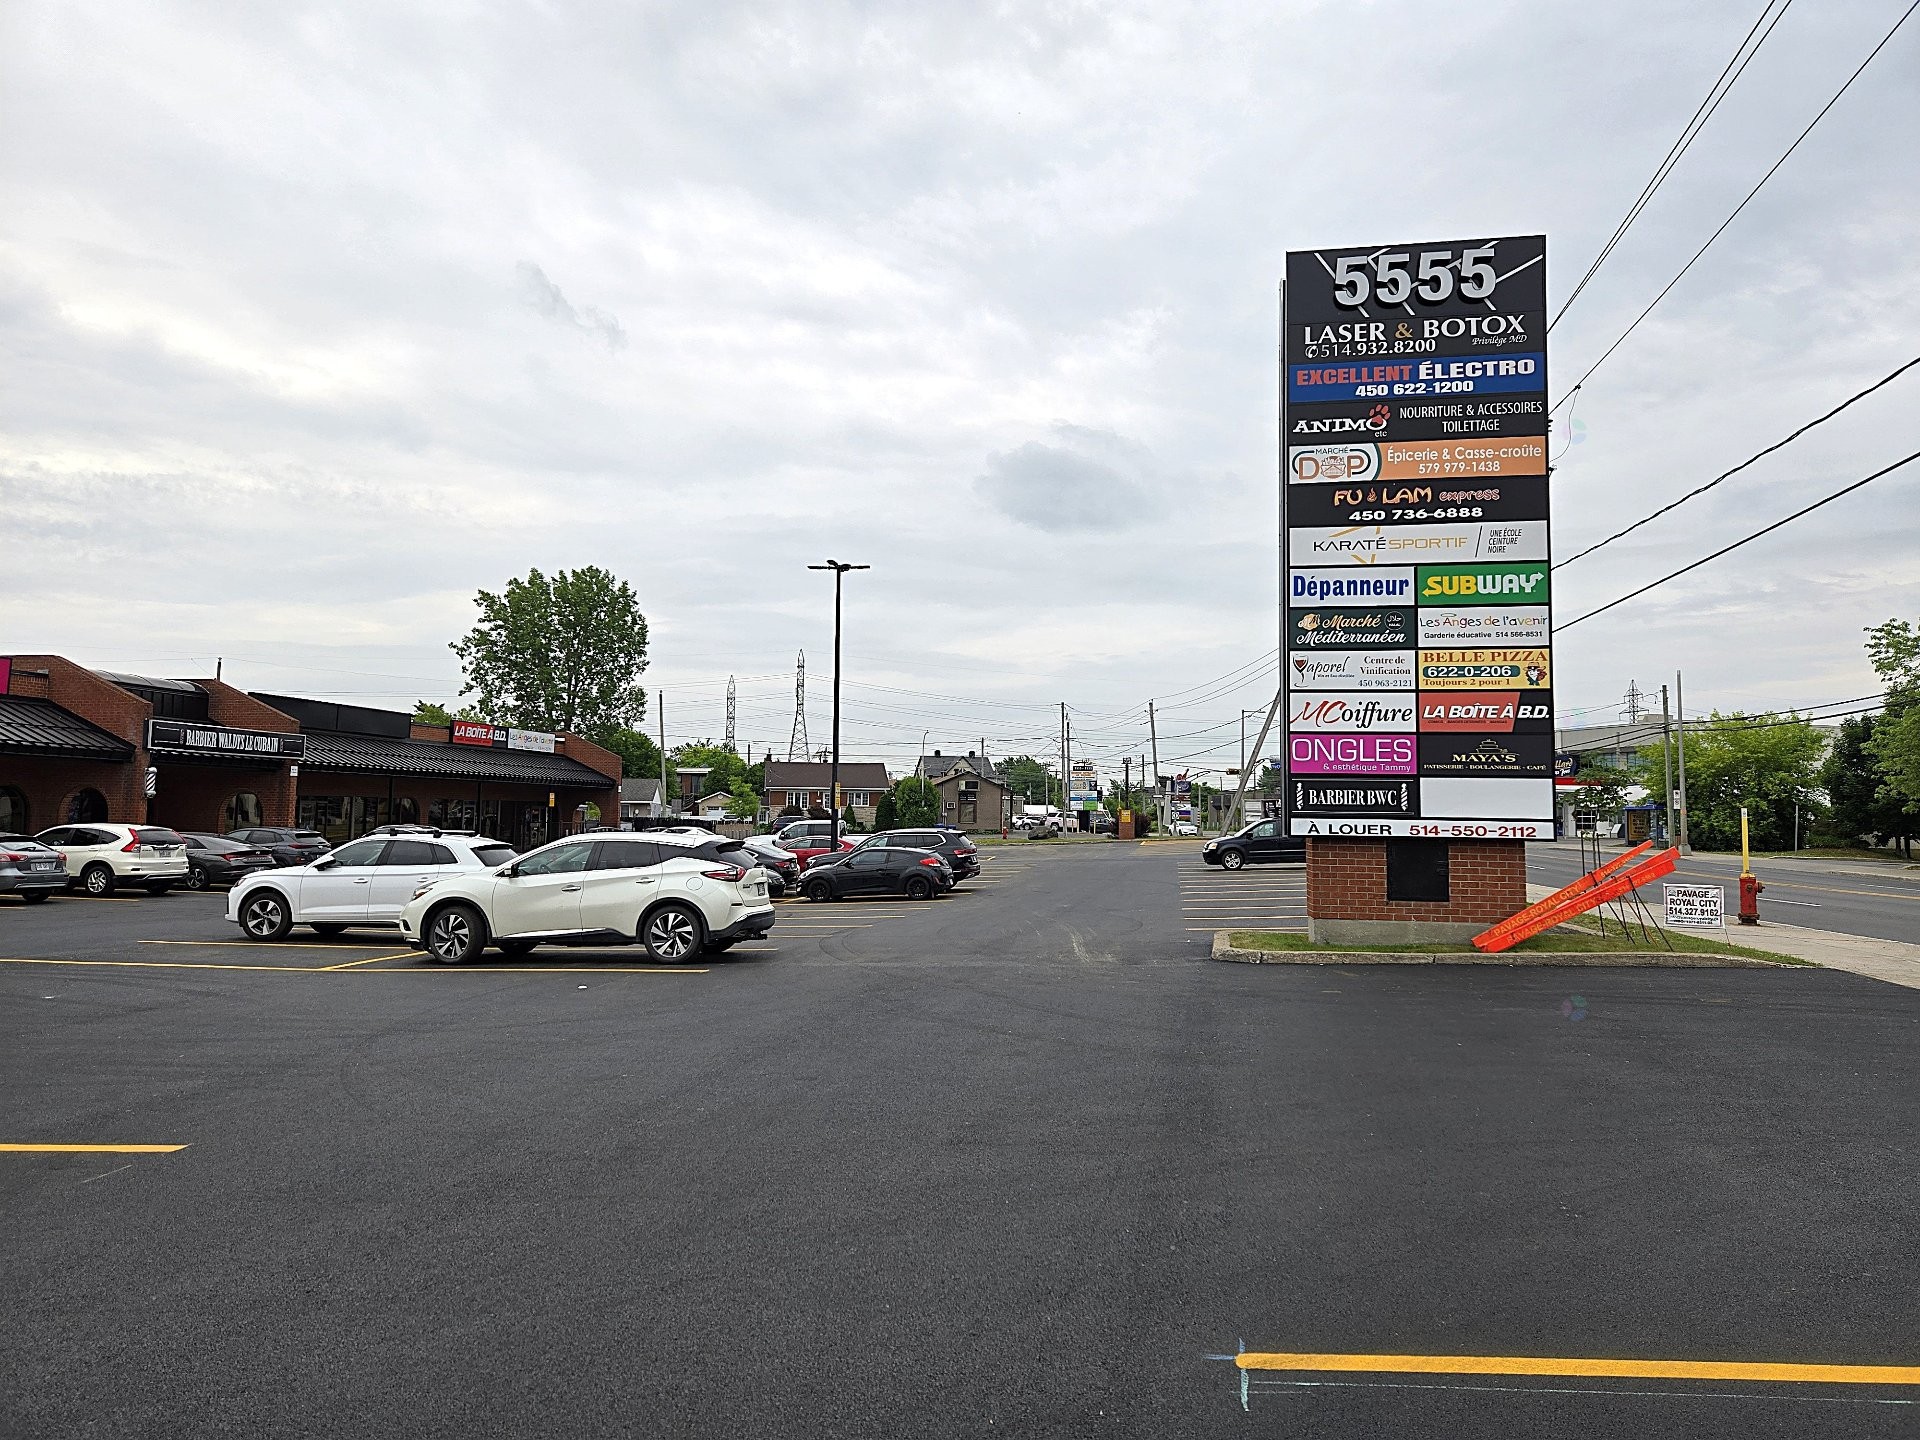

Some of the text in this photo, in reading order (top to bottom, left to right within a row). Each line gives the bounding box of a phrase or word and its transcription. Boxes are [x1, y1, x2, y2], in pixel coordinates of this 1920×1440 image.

[1334, 248, 1498, 306] 5555
[1304, 314, 1525, 345] LASER & BOTOX
[1320, 339, 1436, 359] 514.932.8200
[1296, 359, 1536, 386] EXCELLENT ÉLECTRO
[1355, 380, 1474, 397] 450 622-1200
[1400, 401, 1543, 419] NOURRITURE & ACCESSOIRES
[1292, 417, 1388, 434] ANIMO
[1442, 419, 1500, 433] TOILETTAGE
[1374, 430, 1388, 438] etc
[1315, 446, 1349, 455] MARCHÉ
[1387, 443, 1542, 465] Épicerie & Casse-croûte
[1418, 460, 1500, 474] 579 979-1438
[1333, 486, 1500, 507] FU LAM express
[1349, 507, 1483, 521] 450 736-6888
[1489, 527, 1522, 537] UNE ÉCOLE
[1488, 537, 1518, 545] CEINTURE
[1487, 545, 1507, 554] NOIRE
[1293, 575, 1410, 600] Dépanneur
[1422, 571, 1545, 597] SUBWAY
[1322, 614, 1381, 631] Marché
[1419, 617, 1441, 627] Les
[1442, 617, 1482, 628] Anges
[1484, 616, 1501, 627] de
[1296, 629, 1407, 647] Méditerranéen
[1364, 656, 1405, 664] Centre de
[1423, 650, 1548, 663] BELLE PIZZA
[1360, 666, 1411, 675] Vinification
[1427, 666, 1512, 677] 622-0-206
[1375, 679, 1412, 687] 963-2121
[1423, 678, 1467, 687] Toujours
[1469, 678, 1476, 686] 2
[1478, 679, 1503, 688] pour
[1423, 702, 1550, 718] LA BOÎTE À B.D.
[454, 725, 465, 736] LA
[186, 729, 217, 748] BARBIER
[245, 735, 254, 751] LE
[253, 736, 279, 753] CUBAIN
[1291, 738, 1412, 762] ONGLES
[1452, 754, 1516, 763] MAYA'S
[1332, 763, 1377, 772] esthétique
[1379, 763, 1411, 772] Tammy
[1308, 789, 1397, 806] BARBIER BWC
[1307, 820, 1537, 838] À LOUER 514-550-2112
[1558, 882, 1582, 902] CITY
[1676, 890, 1710, 899] PAVAGE
[1669, 898, 1718, 908] ROYAL CITY
[1668, 906, 1719, 917] 514.327.9162
